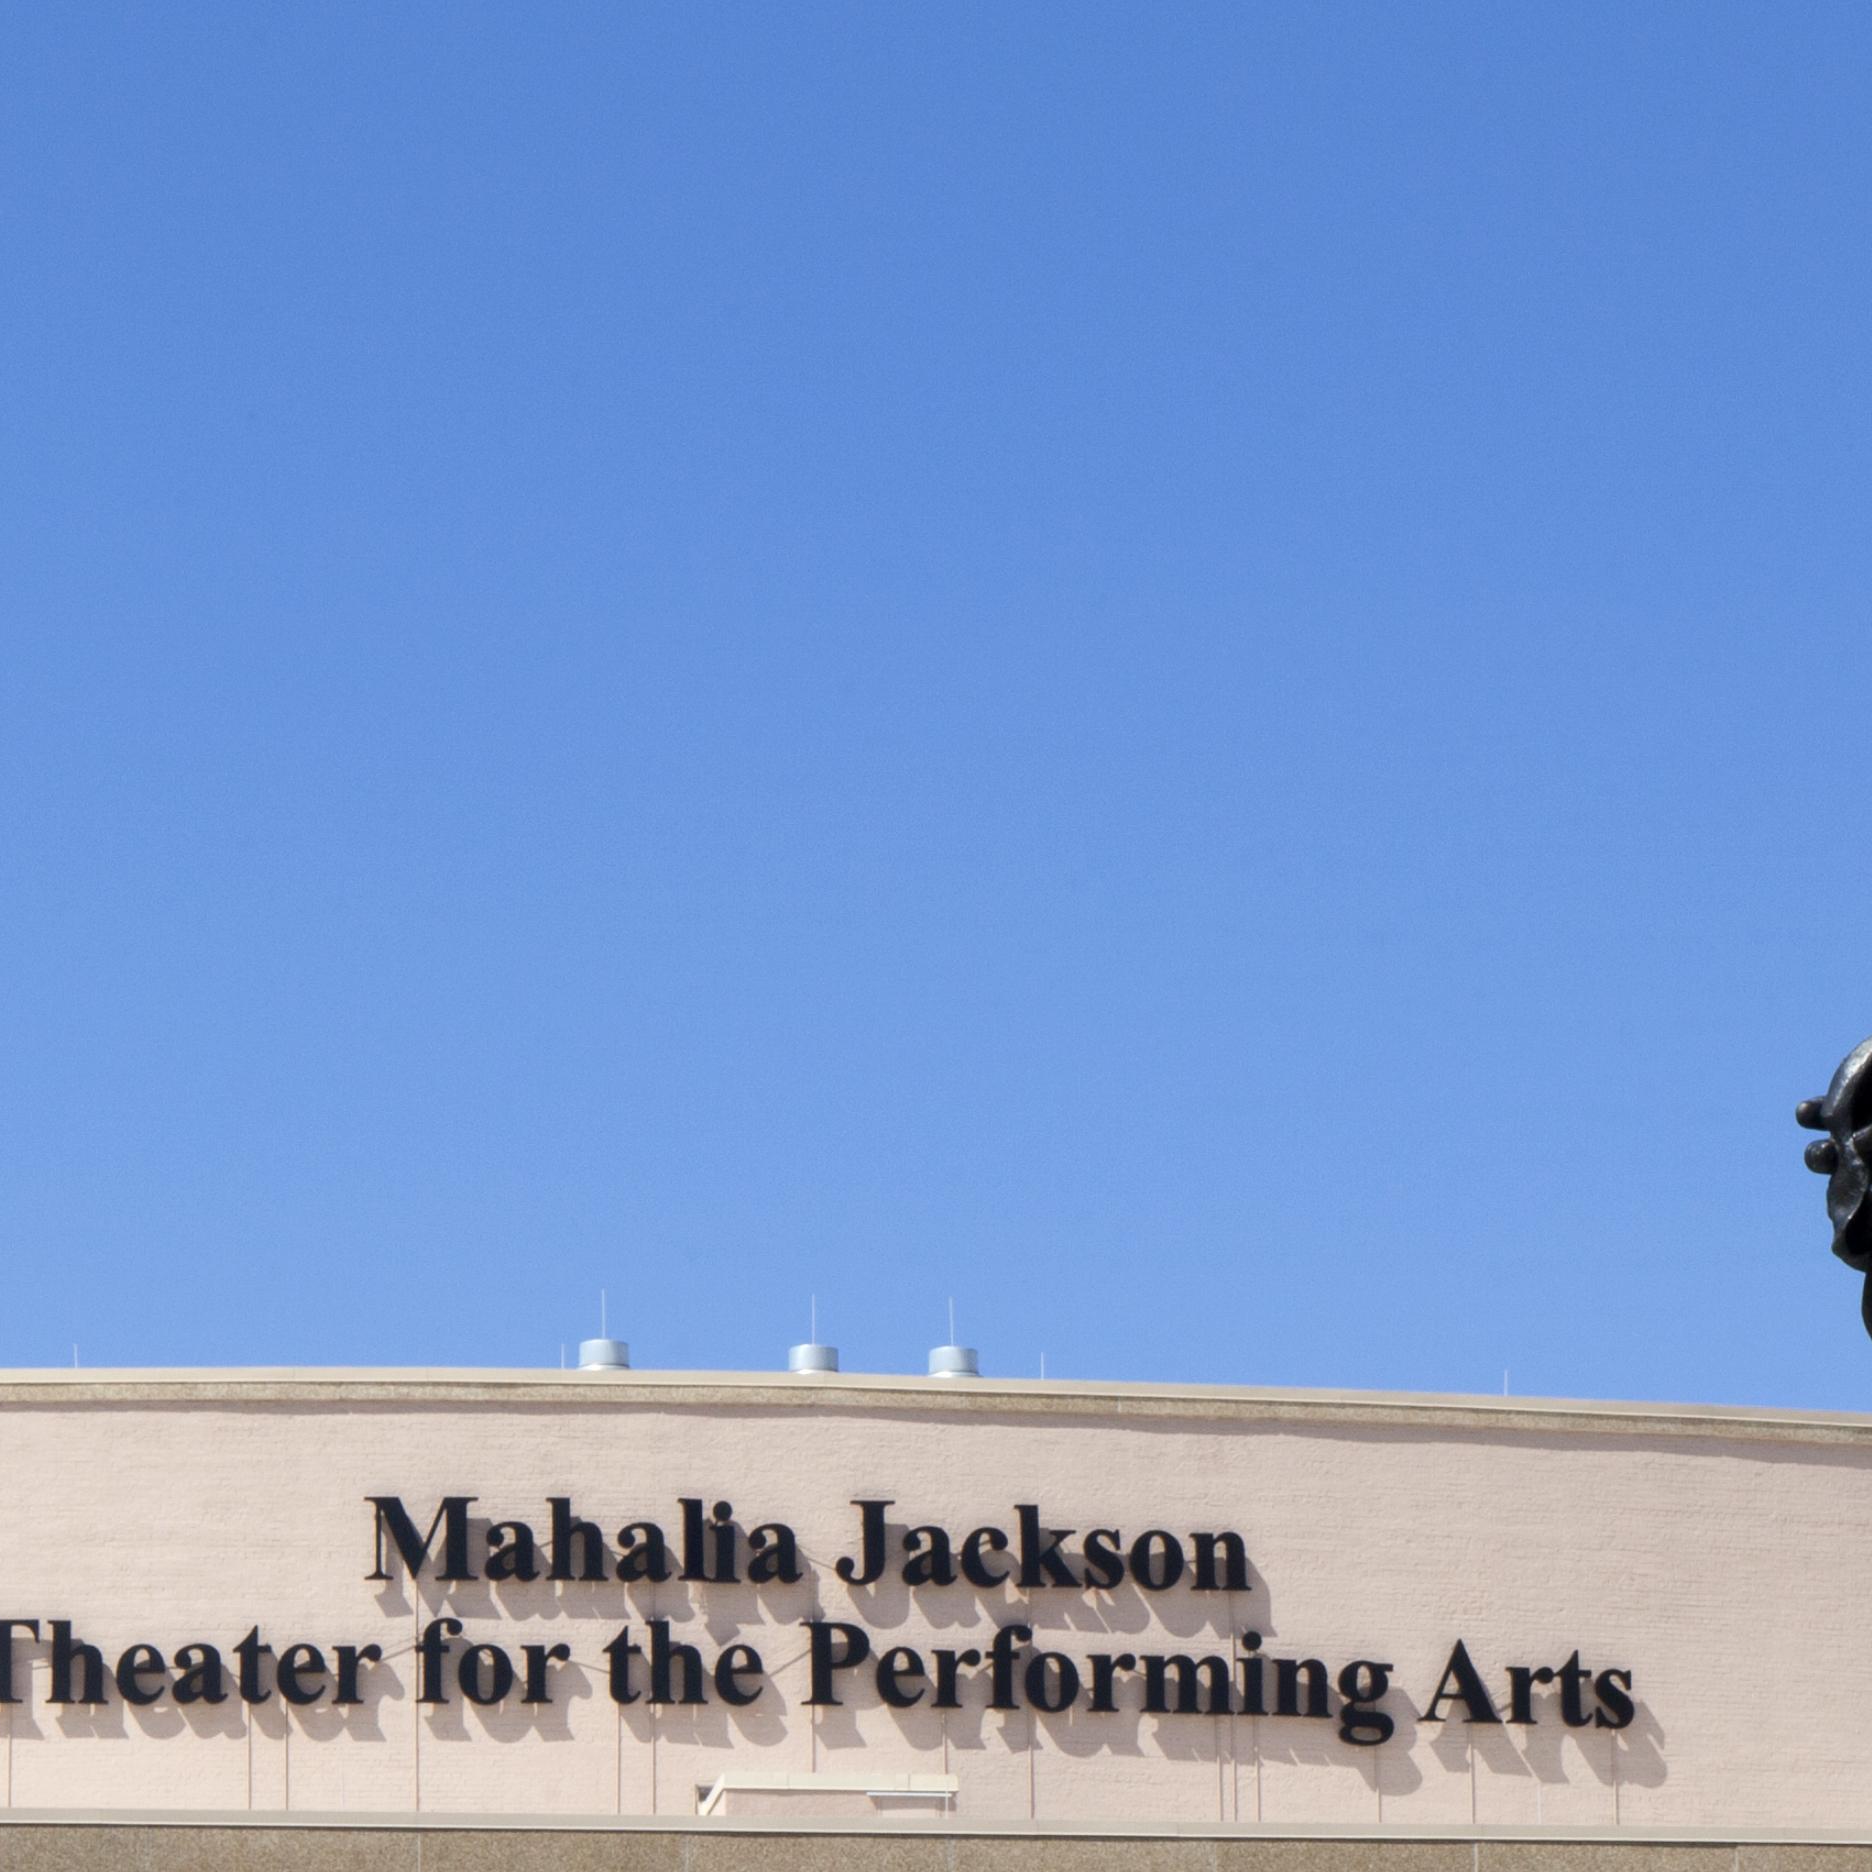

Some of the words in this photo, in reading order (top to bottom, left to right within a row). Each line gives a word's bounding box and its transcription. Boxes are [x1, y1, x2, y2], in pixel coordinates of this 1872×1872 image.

[365, 1497, 803, 1585] Mahalia
[835, 1500, 1252, 1592] Jackson
[415, 1617, 570, 1706] for
[603, 1619, 764, 1707] the
[801, 1620, 1395, 1747] Performing
[1418, 1639, 1636, 1730] Arts
